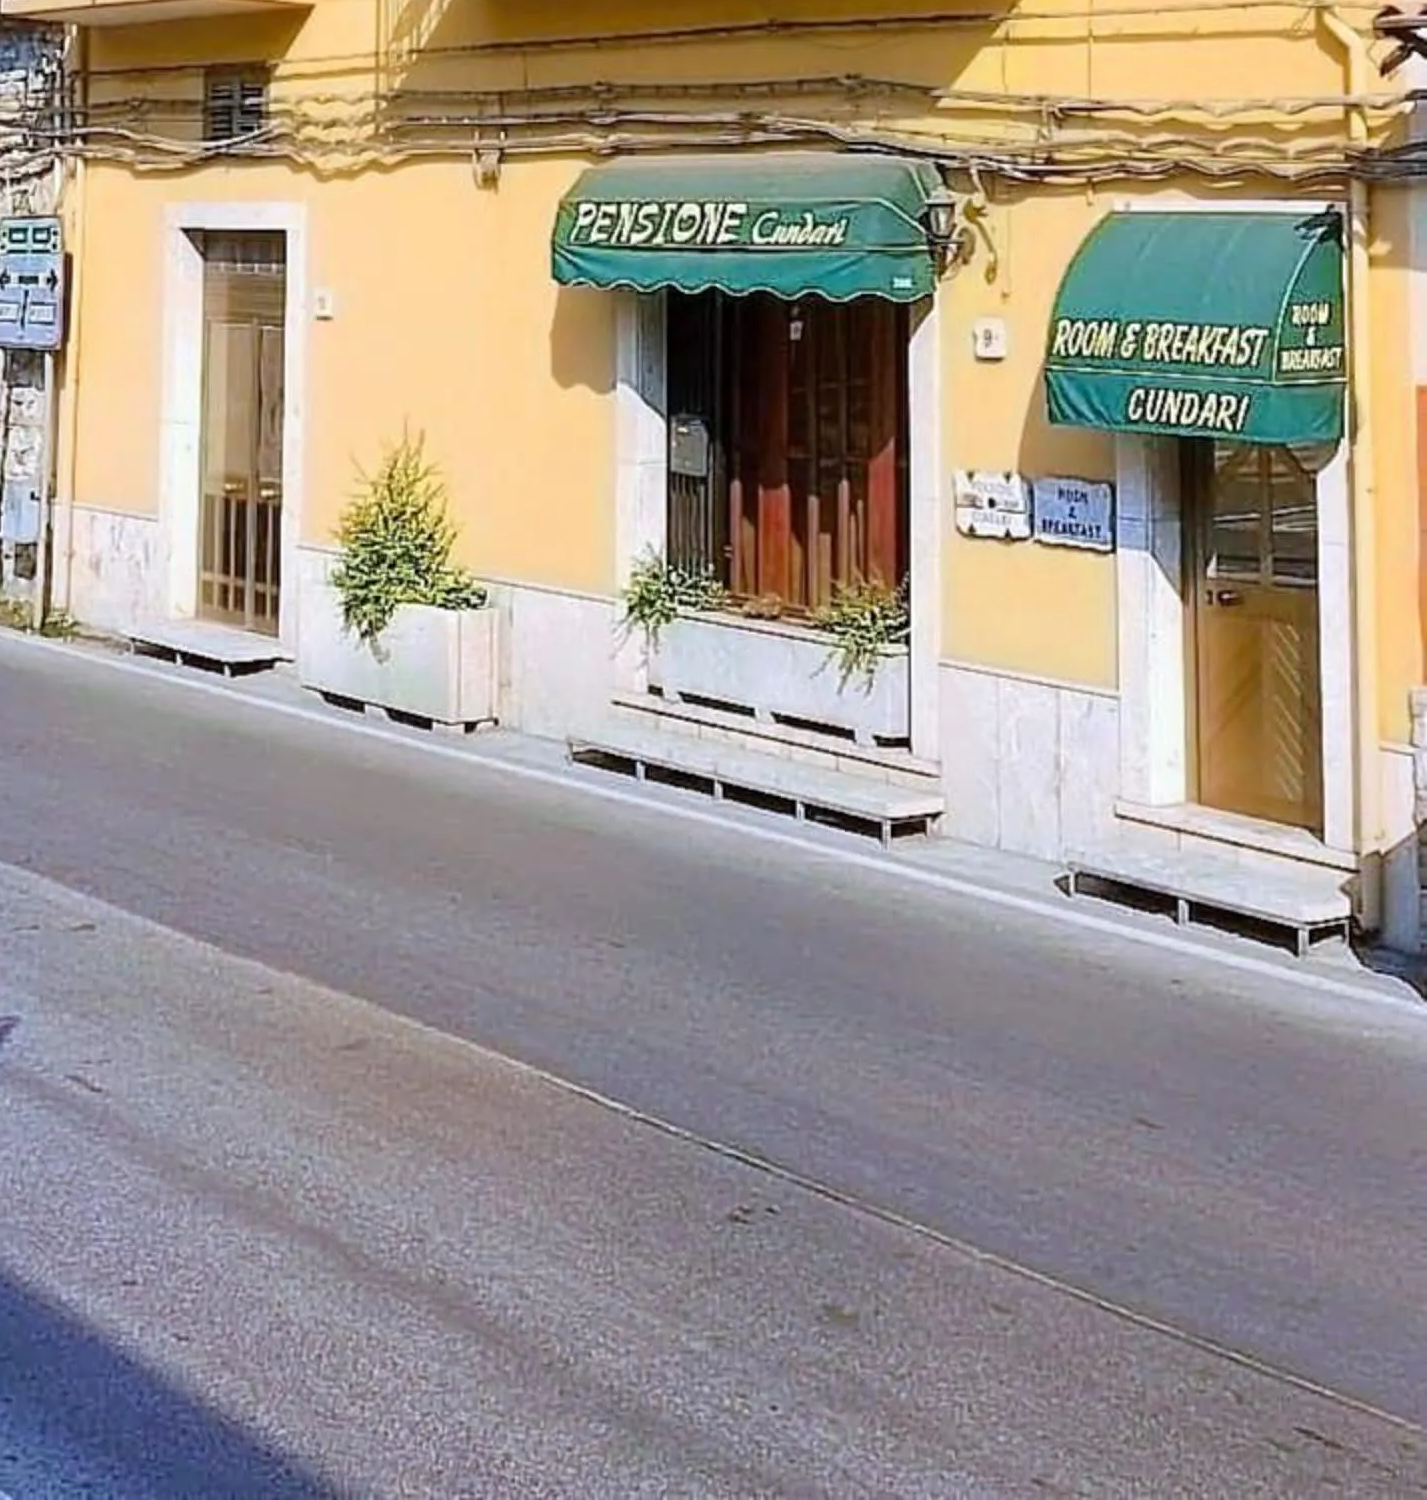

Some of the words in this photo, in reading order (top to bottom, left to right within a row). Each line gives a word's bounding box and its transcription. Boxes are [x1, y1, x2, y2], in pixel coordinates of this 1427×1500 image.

[570, 202, 748, 245] PENSIONE
[1291, 303, 1329, 326] ROOM
[1052, 318, 1118, 357] ROOM
[1120, 321, 1141, 358] &
[1143, 323, 1269, 367] BREAKFAST
[1127, 388, 1250, 431] CUNDARI
